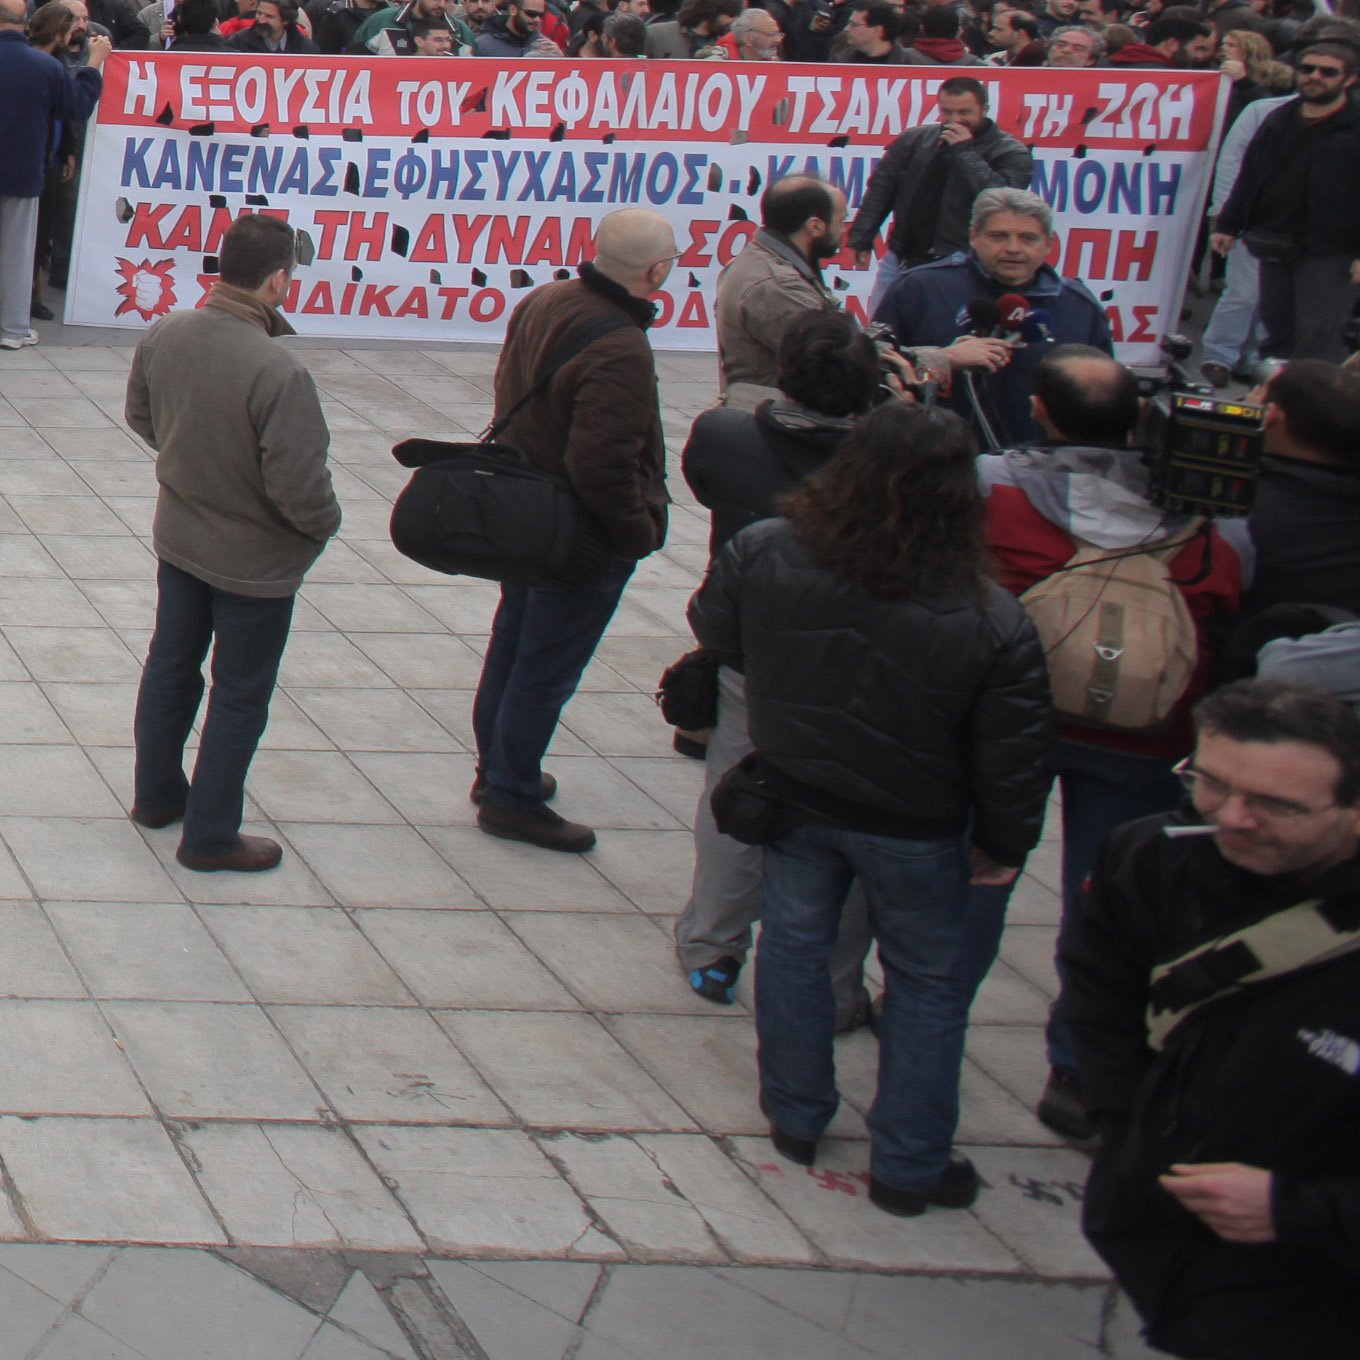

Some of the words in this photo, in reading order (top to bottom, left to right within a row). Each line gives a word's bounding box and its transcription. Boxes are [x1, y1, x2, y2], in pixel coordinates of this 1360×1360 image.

[123, 60, 158, 117] Η
[180, 64, 374, 125] ΕΞΟΥΣΙΑ
[396, 80, 472, 127] ΤΟΥ
[491, 69, 767, 133] ΚΕΦΑΛΑΙΟΥ
[1023, 93, 1074, 139] ΤΗ
[1084, 81, 1195, 140] ΖΩΗ
[120, 137, 343, 197] ΚΑΝΕΝΑΣ
[362, 147, 708, 206] ΕΦΗΣΥΧΑΣΜΟΣ
[312, 209, 390, 262] ΤΗ
